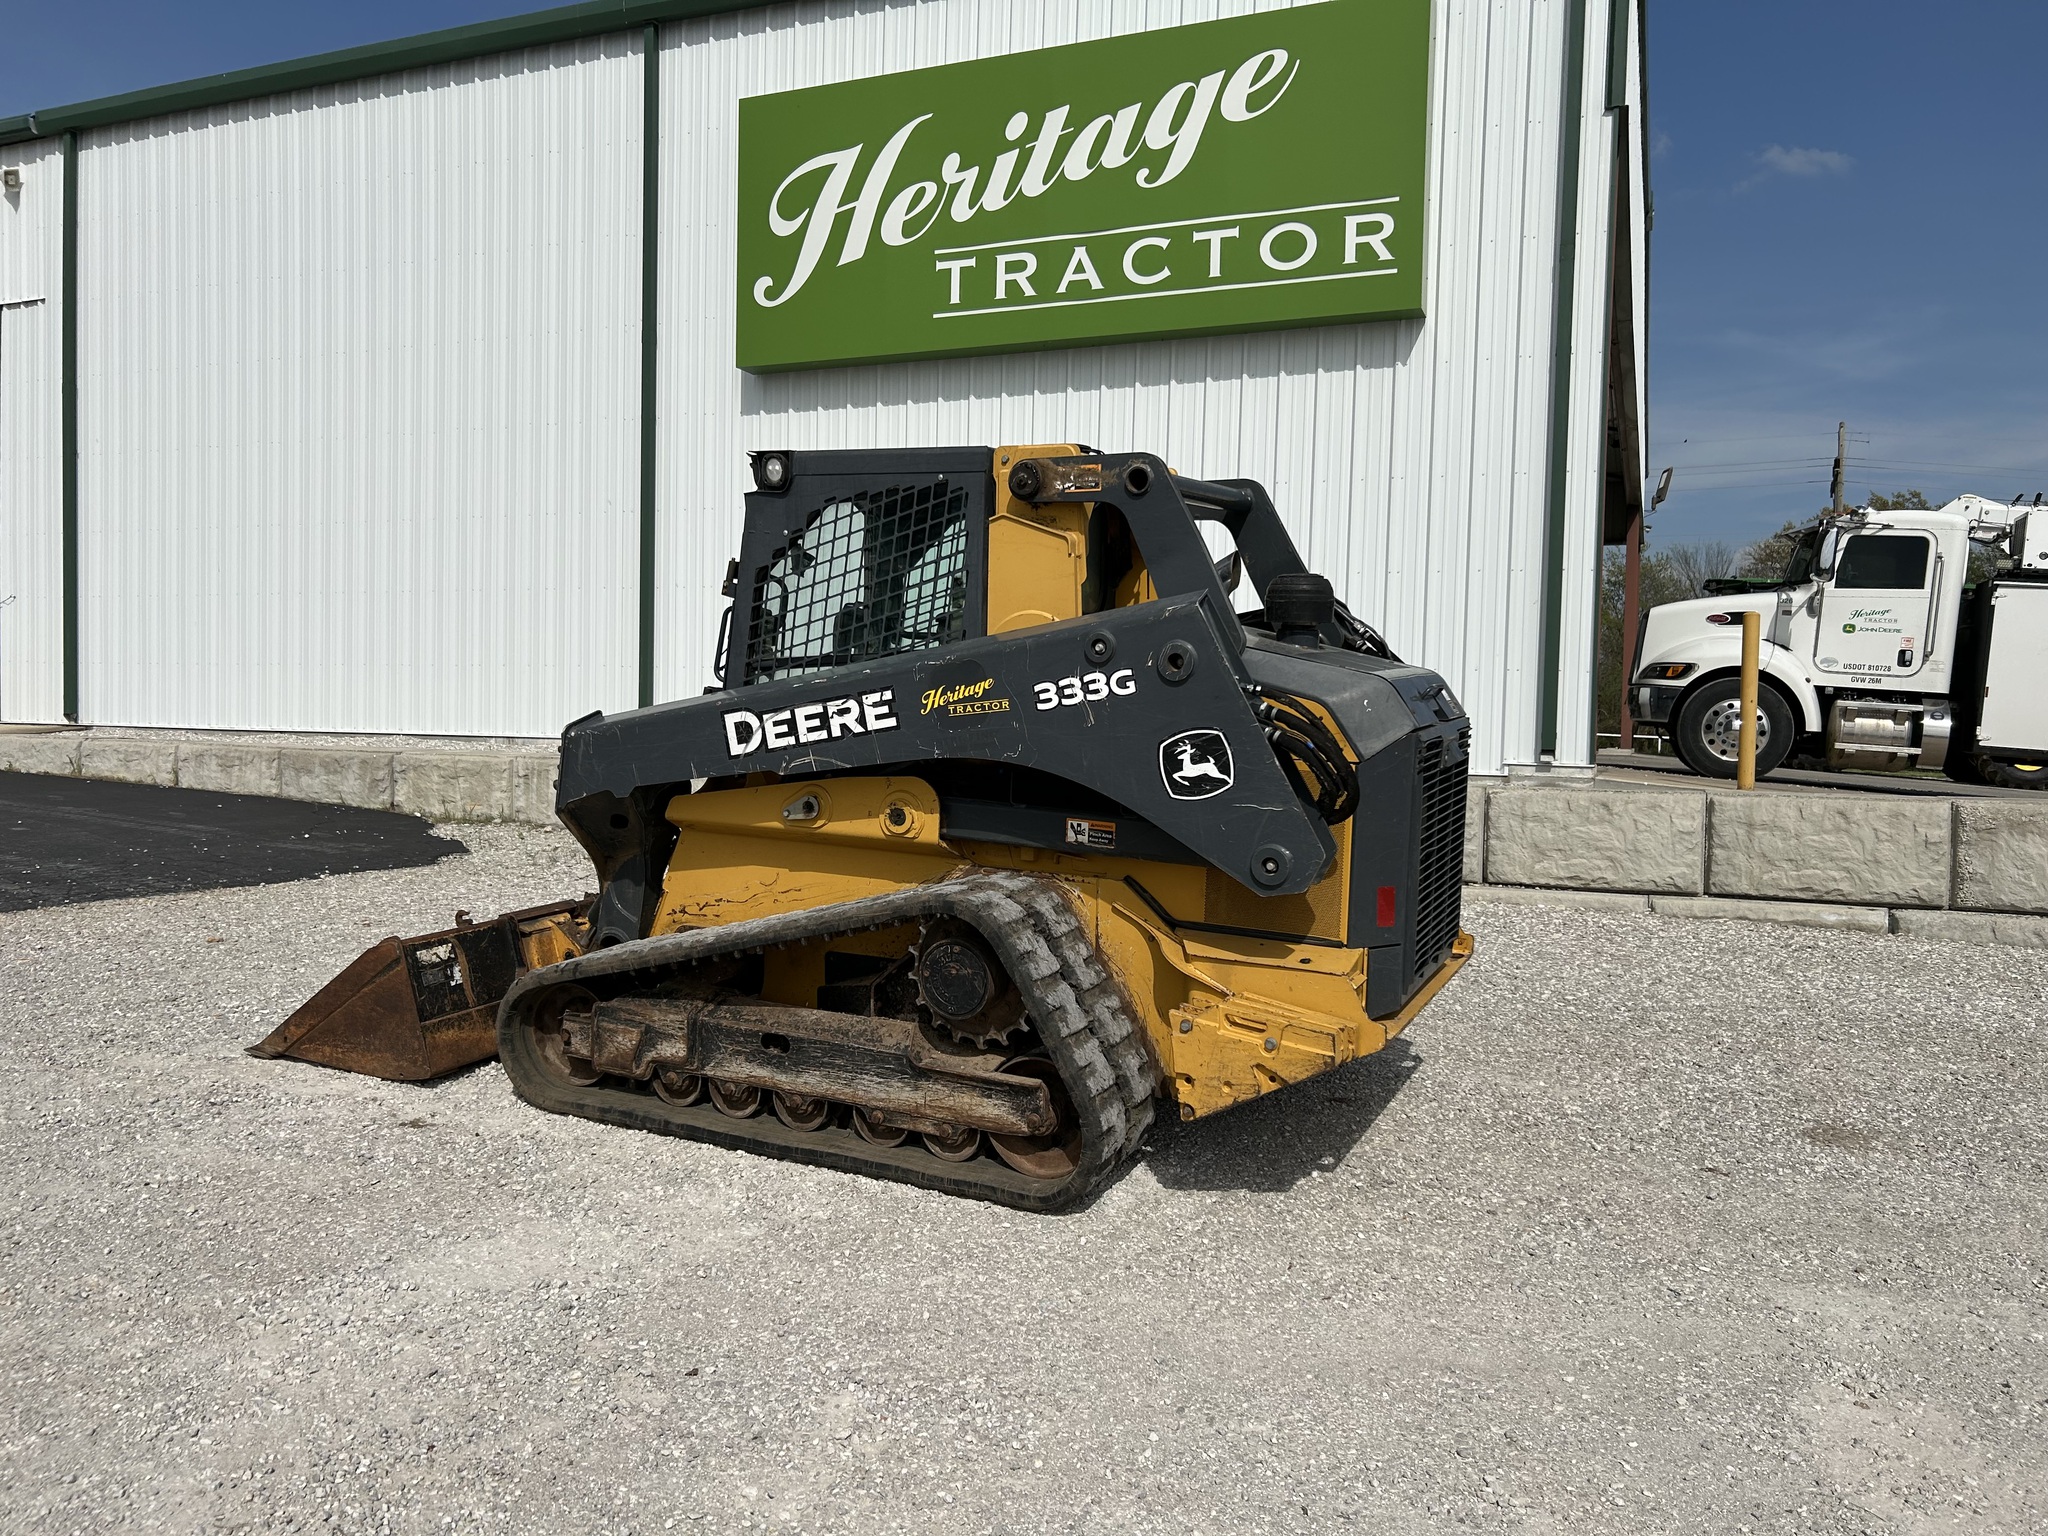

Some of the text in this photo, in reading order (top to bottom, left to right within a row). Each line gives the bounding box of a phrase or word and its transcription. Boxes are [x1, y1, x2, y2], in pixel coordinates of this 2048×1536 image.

[754, 48, 1300, 307] Heritage
[935, 212, 1396, 305] TRACTOR
[1848, 608, 1892, 620] Heritage
[1843, 663, 1866, 671] USDOT
[920, 678, 995, 715] Heritage
[948, 701, 1010, 715] TRACTOR
[1033, 668, 1137, 711] 333G
[723, 690, 898, 757] DEERE
